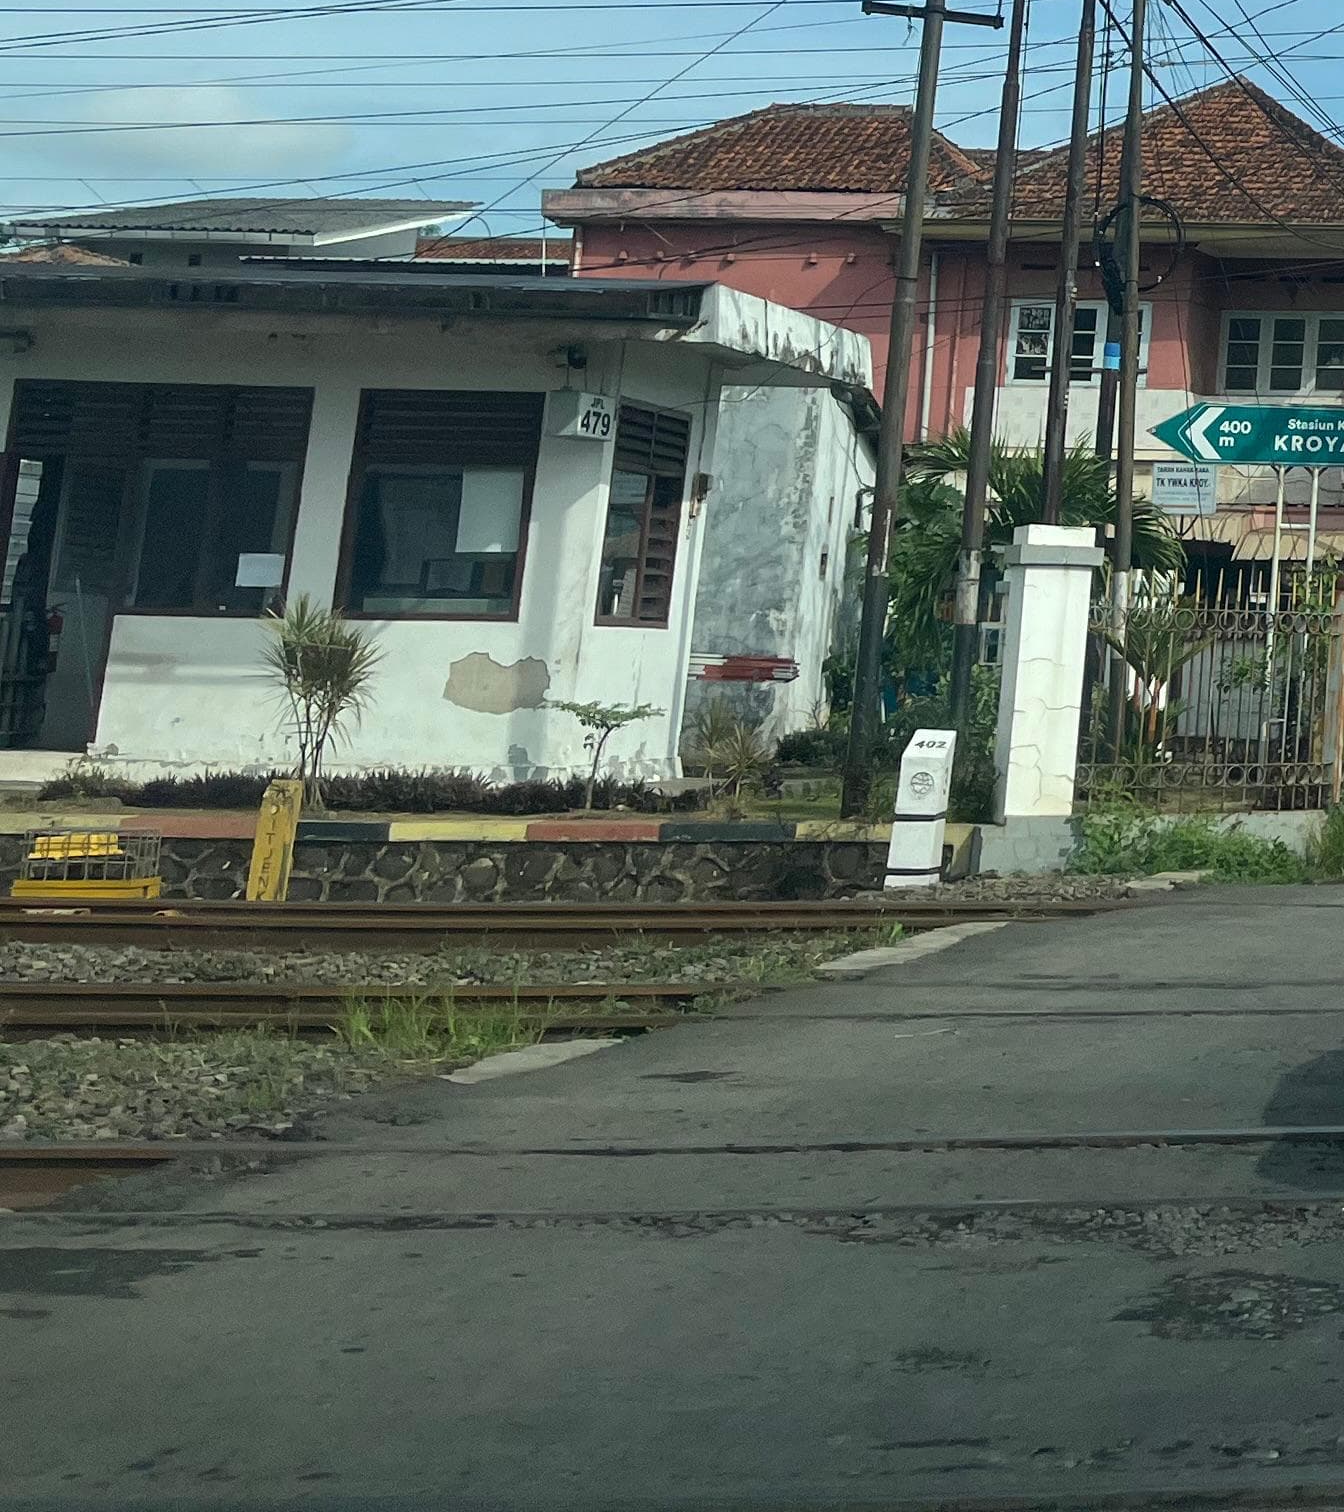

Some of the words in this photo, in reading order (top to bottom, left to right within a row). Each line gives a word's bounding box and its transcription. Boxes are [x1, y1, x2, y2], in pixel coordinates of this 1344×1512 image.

[581, 410, 610, 436] 479
[1219, 421, 1251, 434] 400
[1287, 418, 1334, 431] Stasiun
[1219, 436, 1235, 448] m
[914, 740, 947, 749] 402
